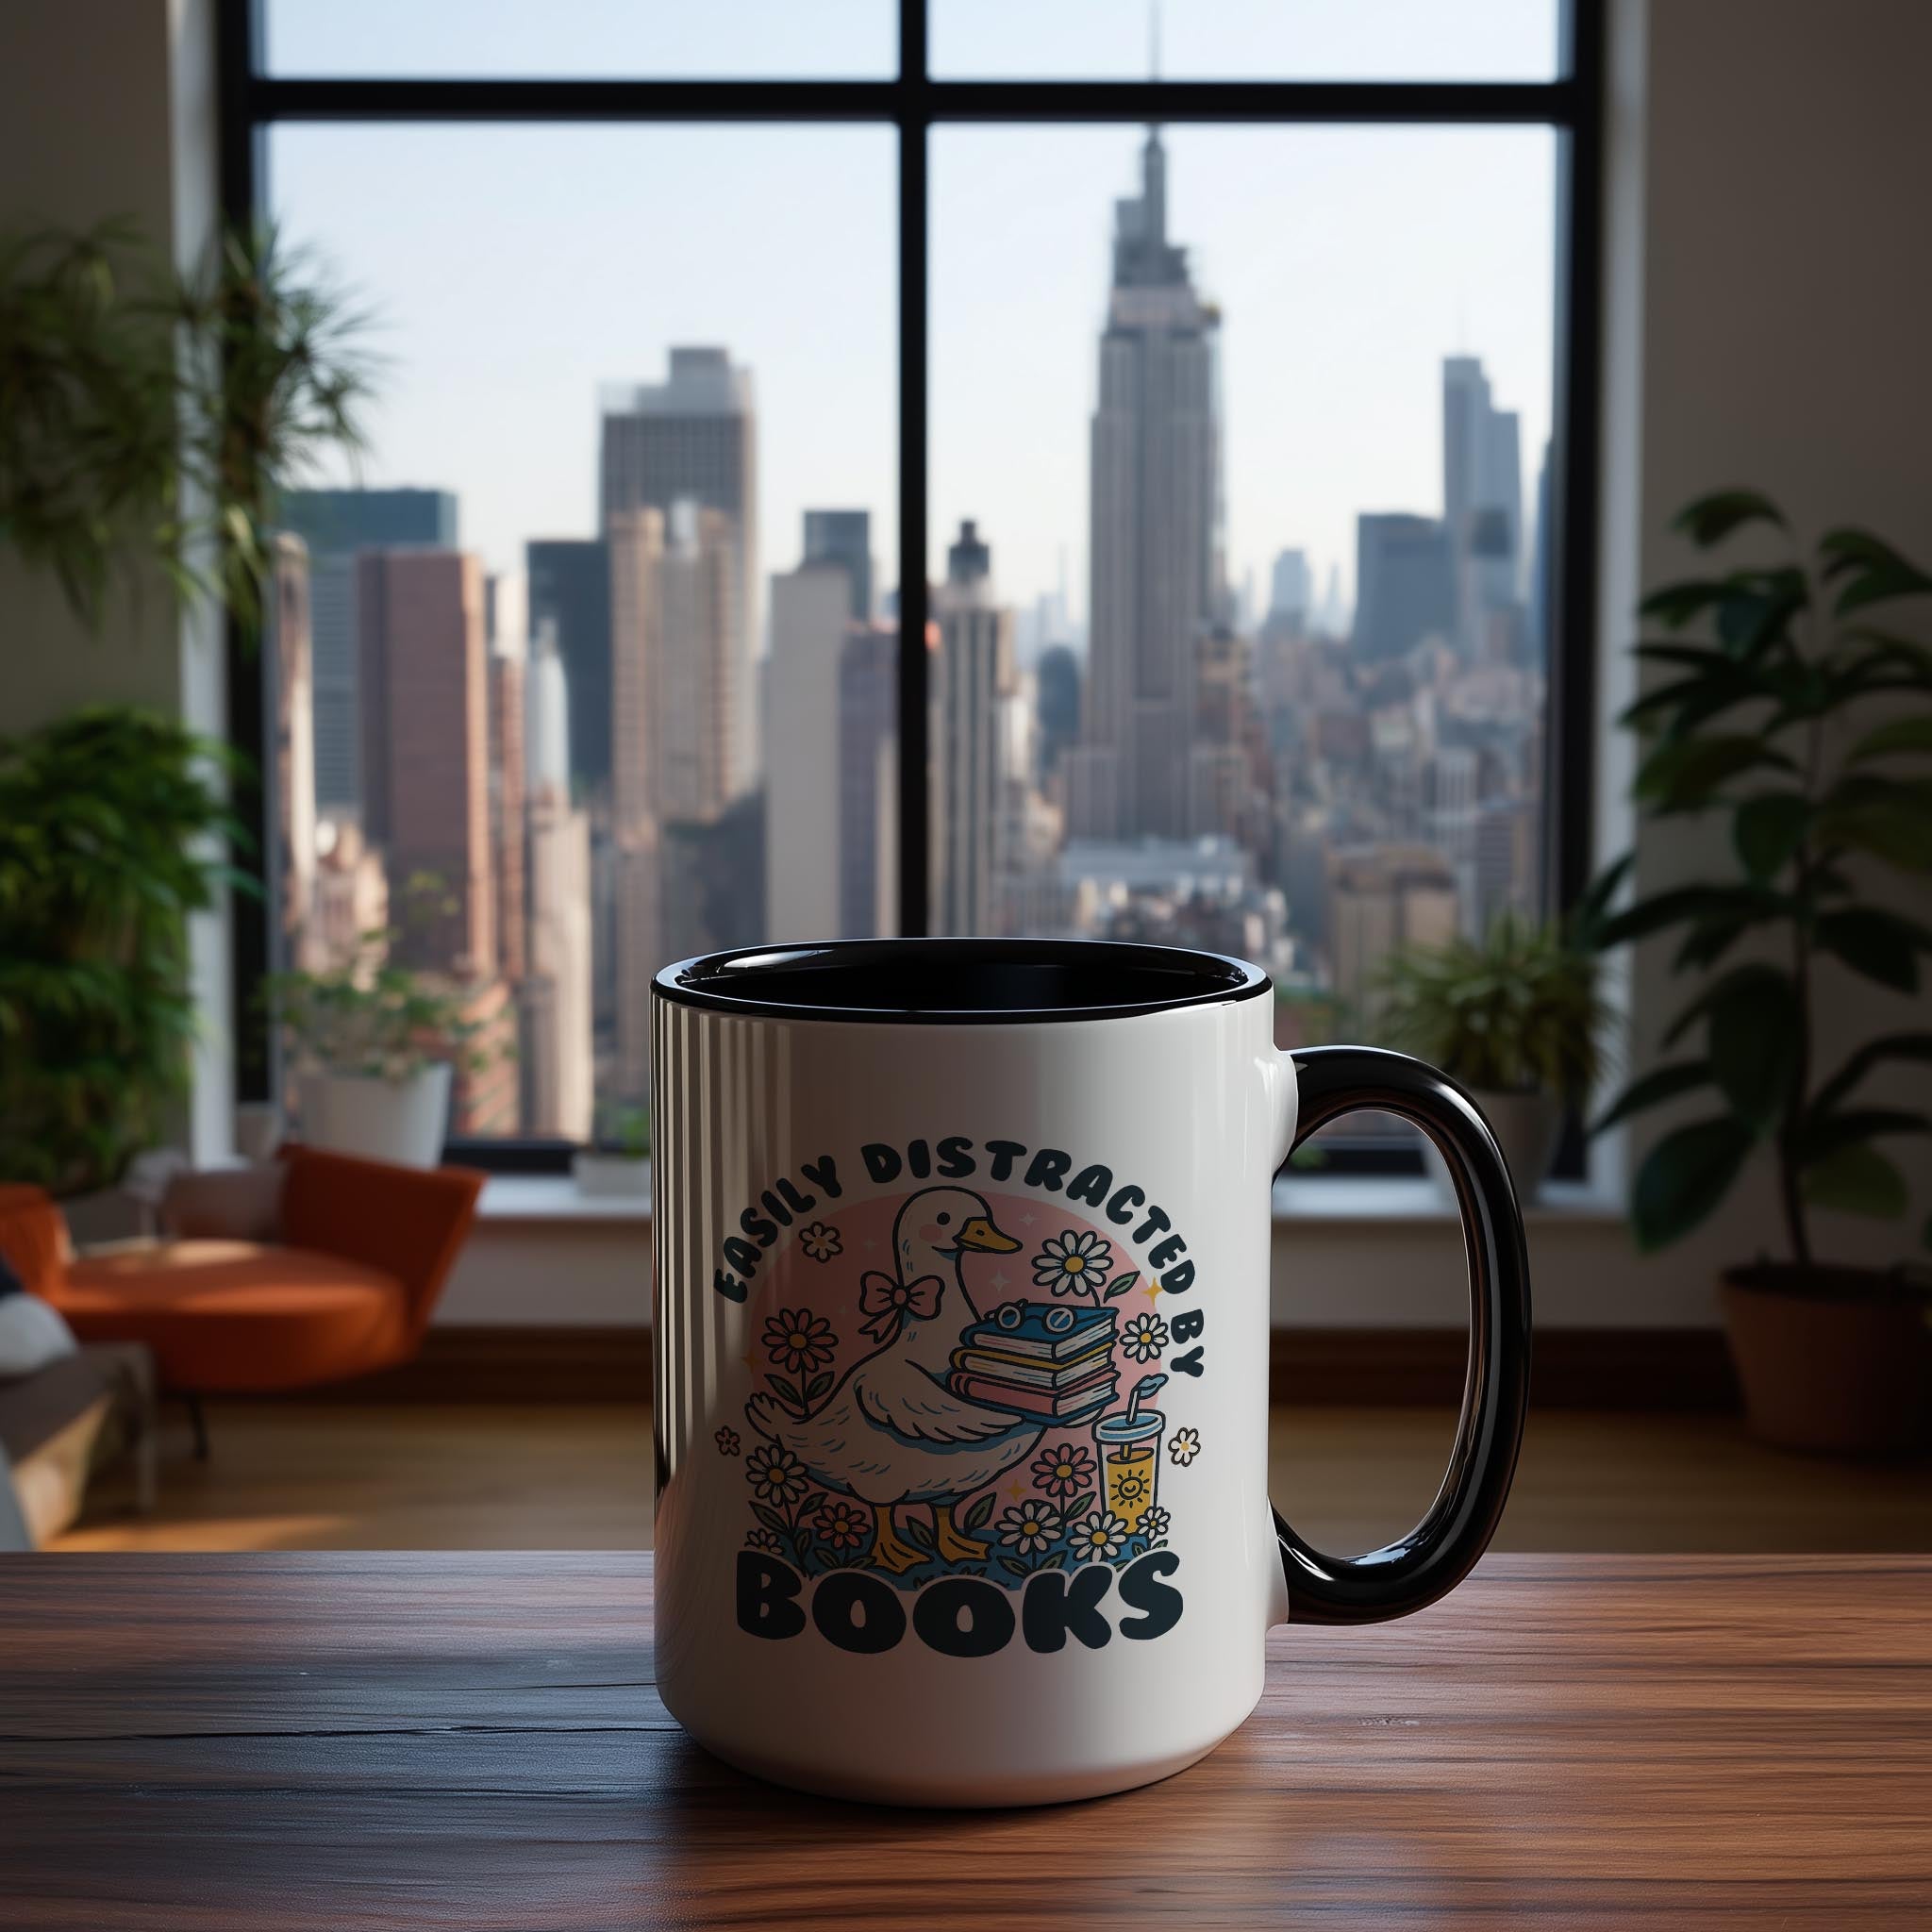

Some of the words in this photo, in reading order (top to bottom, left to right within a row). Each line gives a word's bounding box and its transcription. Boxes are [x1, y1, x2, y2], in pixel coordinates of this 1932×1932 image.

[713, 1155, 843, 1304] EASILY
[860, 1137, 1196, 1295] DISTRACTED
[1170, 1308, 1205, 1378] BY
[736, 1550, 1184, 1657] BOOKS
